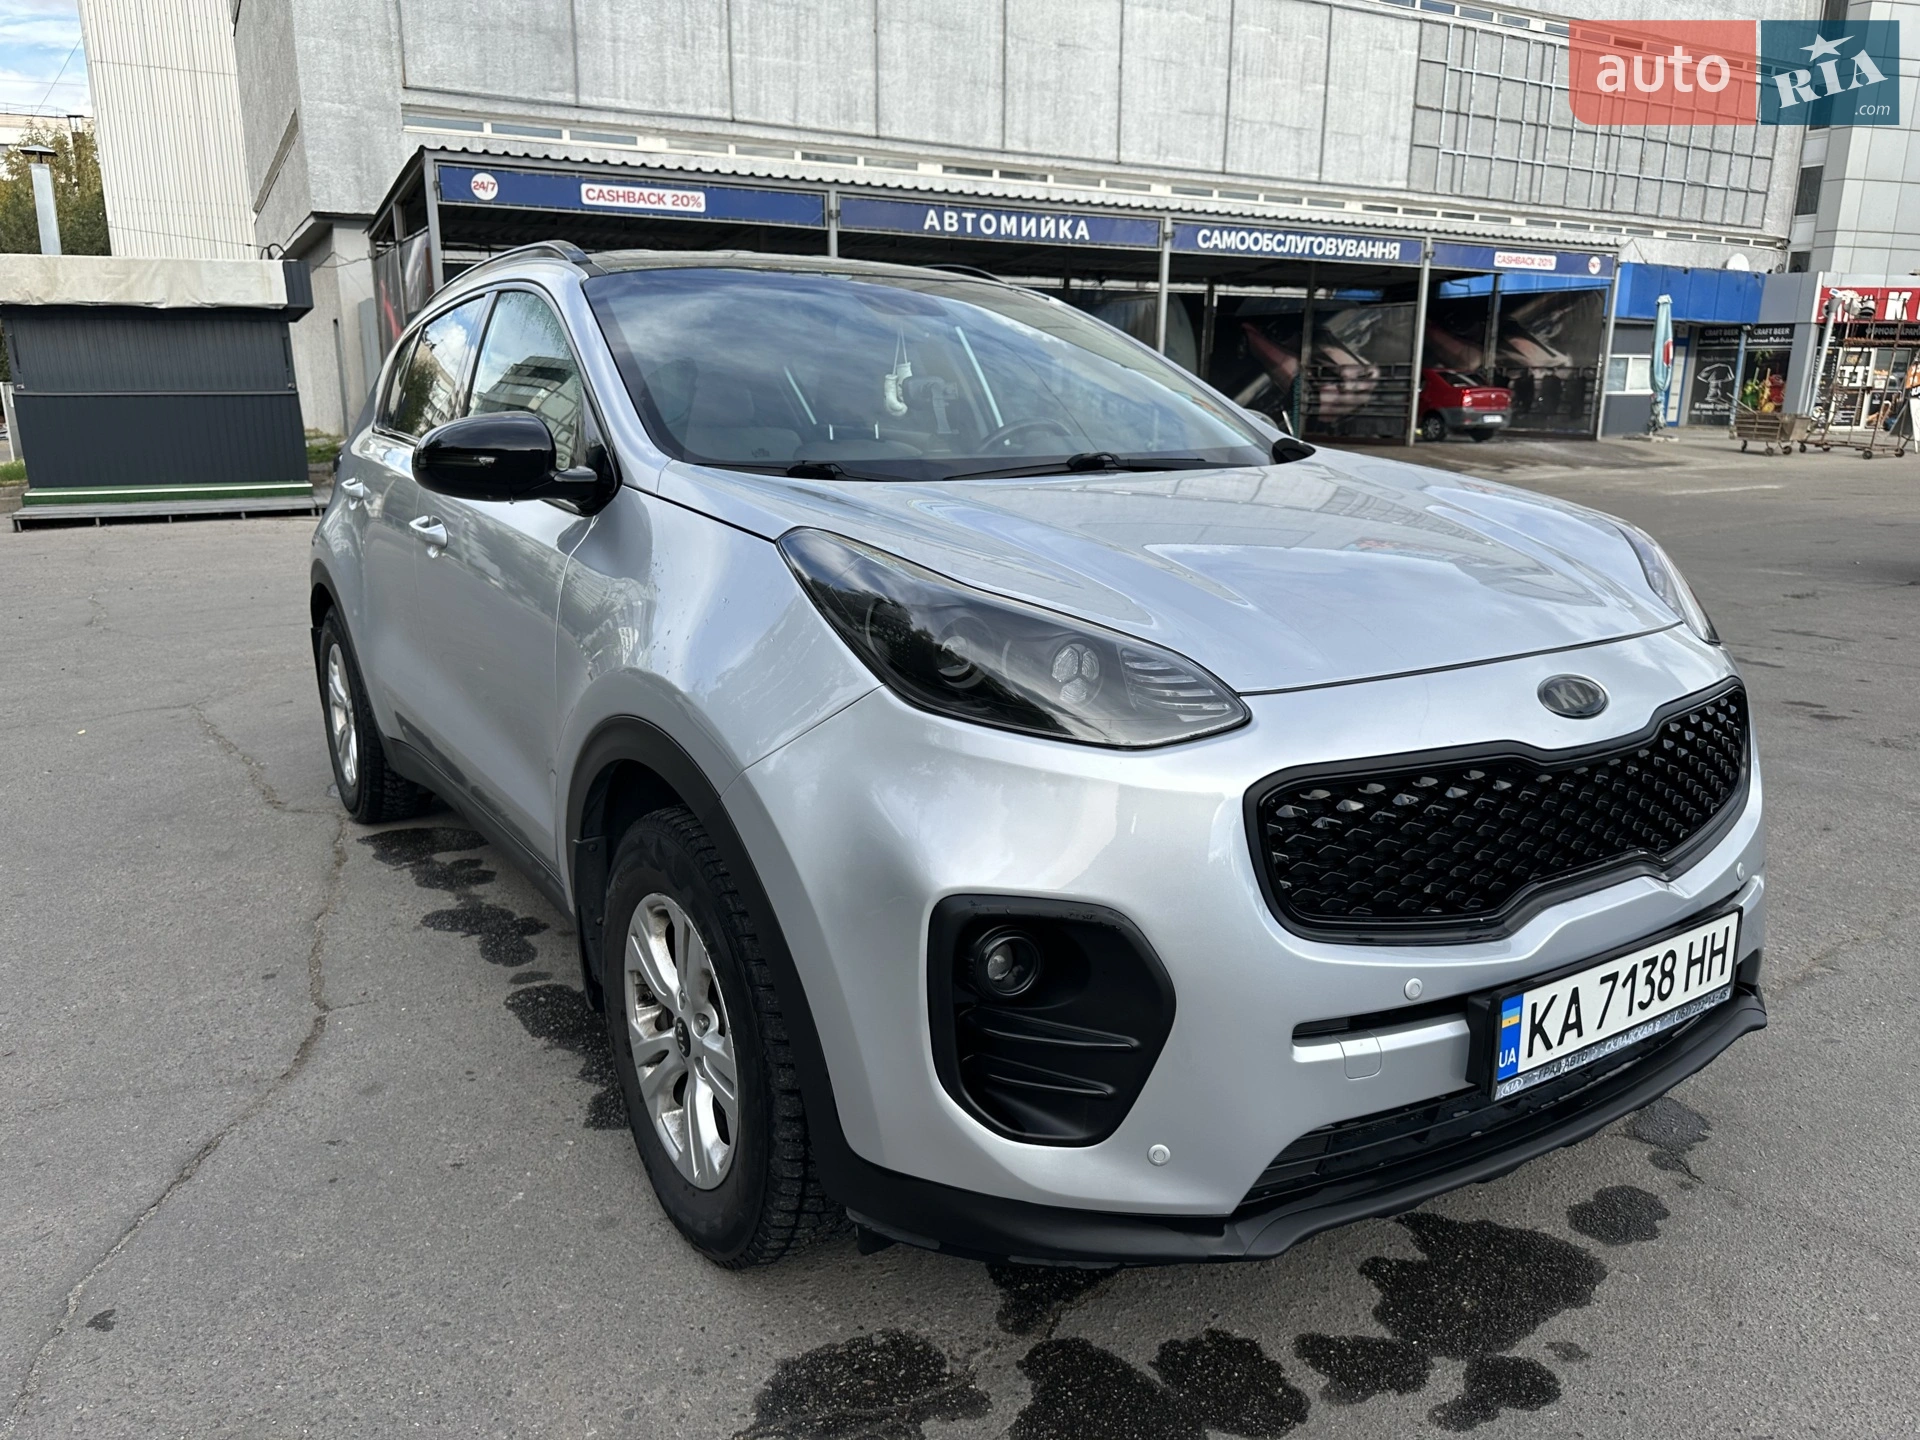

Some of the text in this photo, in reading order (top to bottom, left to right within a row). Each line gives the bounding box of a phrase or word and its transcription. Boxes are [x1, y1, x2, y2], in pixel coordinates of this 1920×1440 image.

[472, 180, 497, 192] 24/7
[585, 188, 702, 209] CASHBACK 20%
[923, 209, 1090, 241] АВТОМИЙКА
[1197, 228, 1400, 260] САМООБСЛУГОВУВАННЯ
[1496, 254, 1535, 266] CASHBACK
[1527, 925, 1730, 1058] KA 7138 HH
[1499, 1047, 1517, 1068] UA
